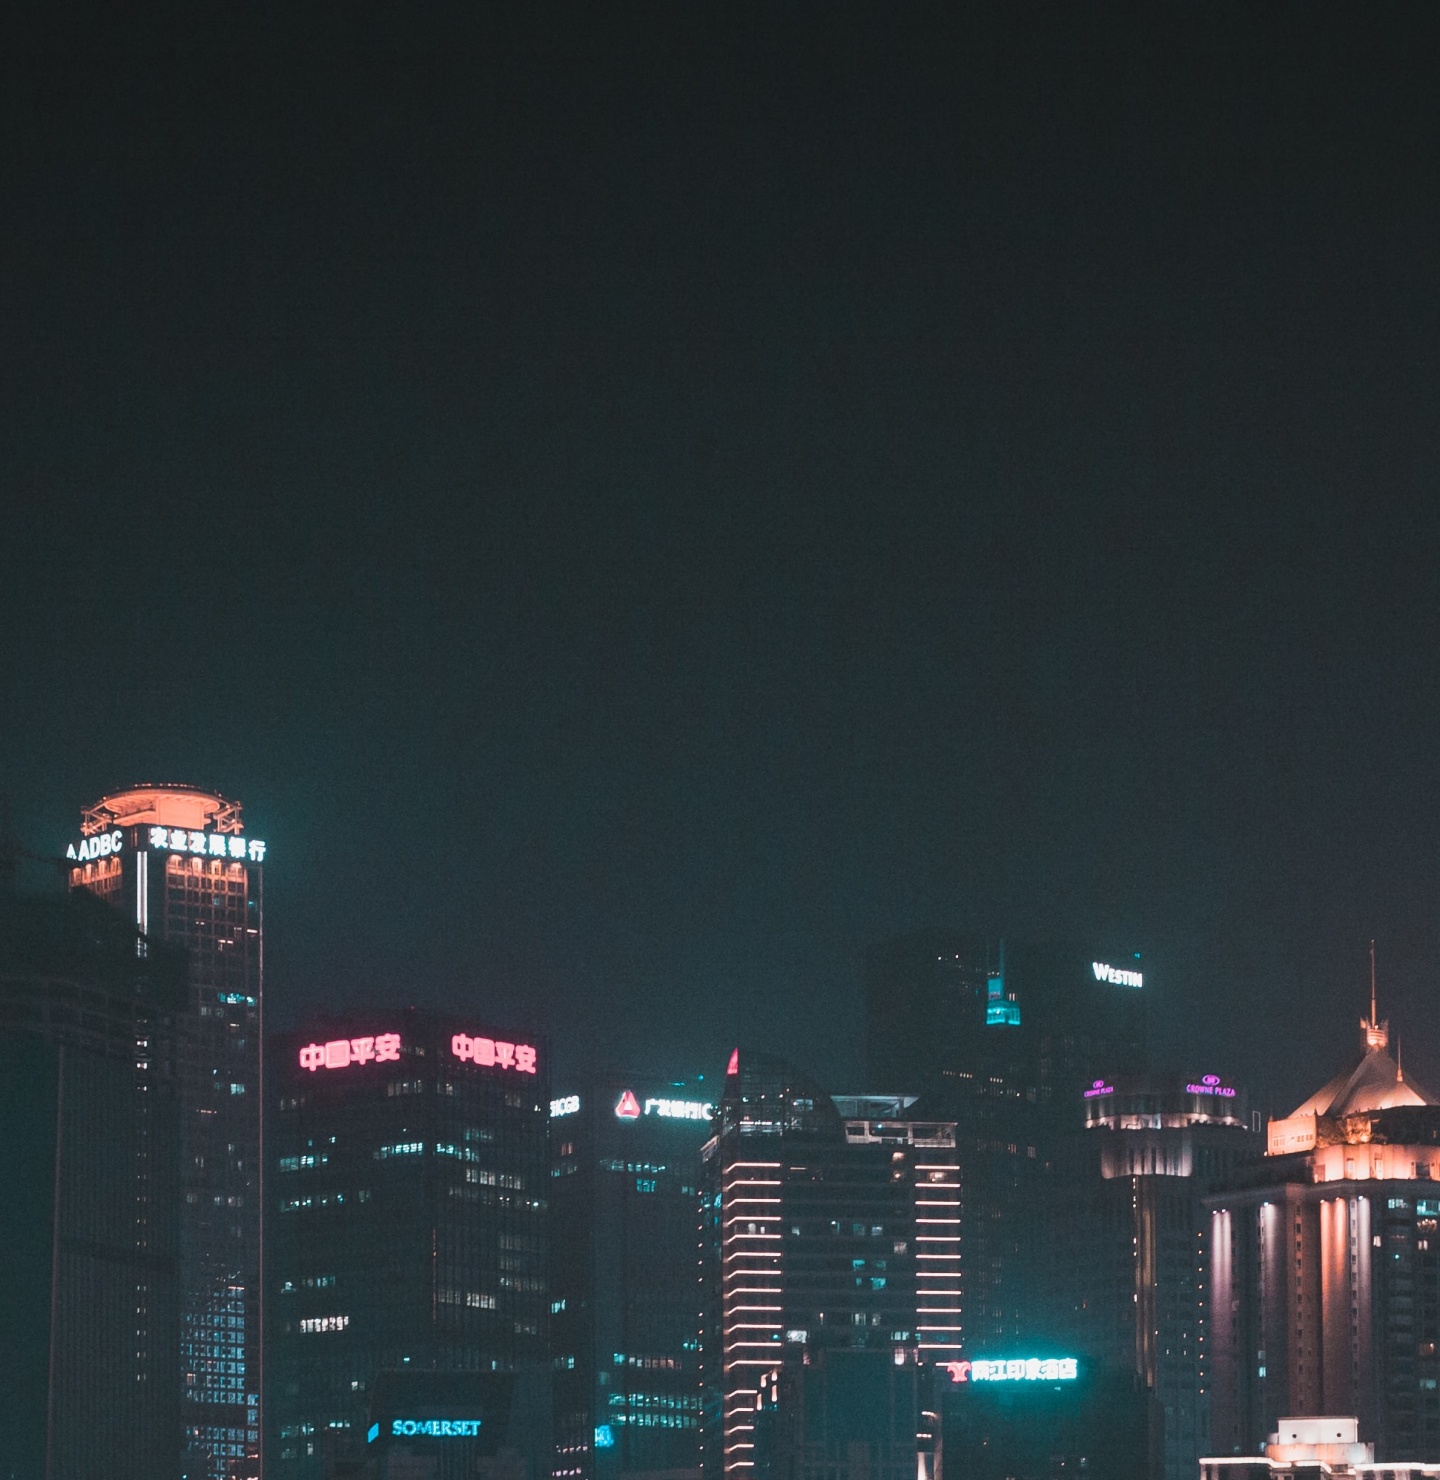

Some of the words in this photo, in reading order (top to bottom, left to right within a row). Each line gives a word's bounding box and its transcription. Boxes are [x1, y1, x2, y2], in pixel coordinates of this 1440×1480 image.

[78, 830, 123, 862] ADBC
[150, 826, 267, 862] 农业发展银行
[299, 1033, 400, 1071] 中国平安
[451, 1033, 537, 1074] 中国平安
[1186, 1083, 1214, 1095] CROWNE
[1214, 1086, 1236, 1097] PLAZA
[392, 1419, 482, 1436] SOMERSET
